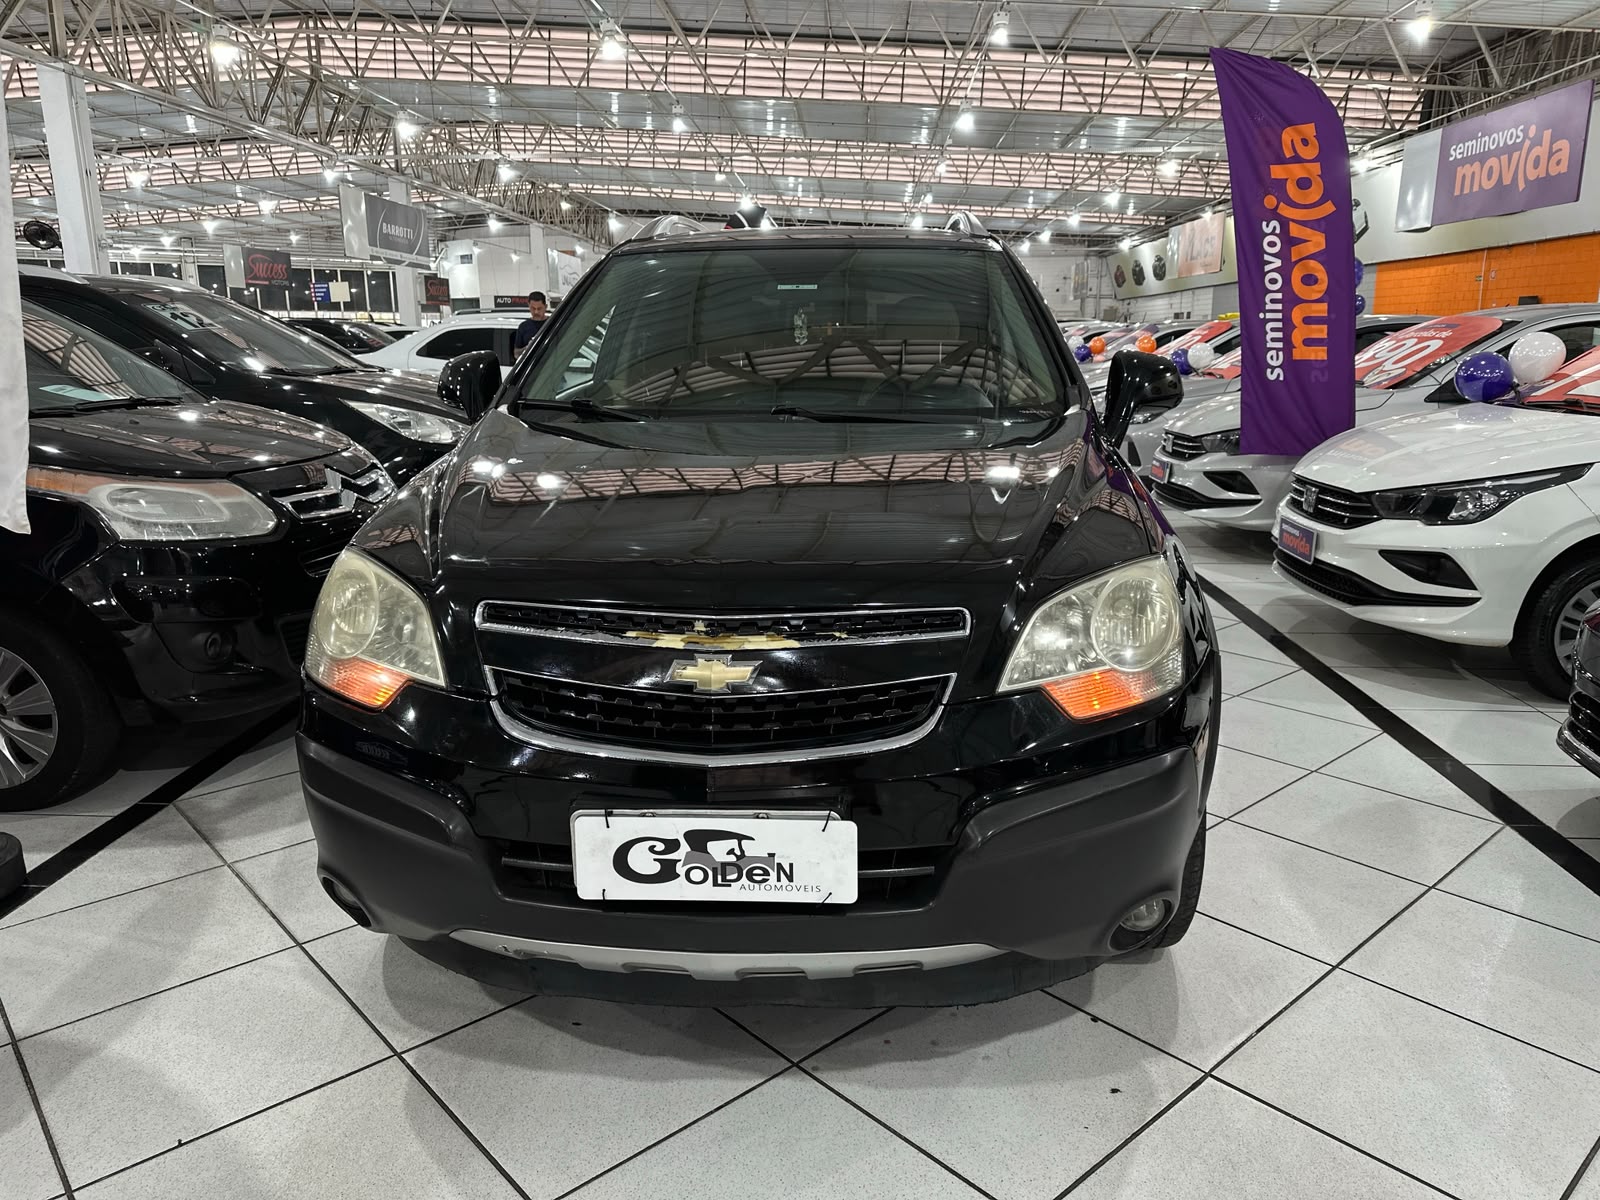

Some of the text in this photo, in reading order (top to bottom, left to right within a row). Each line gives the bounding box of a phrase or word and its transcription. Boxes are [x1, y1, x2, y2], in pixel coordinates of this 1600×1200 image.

[1449, 124, 1525, 161] seminovos
[1454, 124, 1571, 196] movida
[382, 222, 414, 240] BARROTTI
[1263, 122, 1336, 360] movida
[1258, 220, 1284, 381] seminovos
